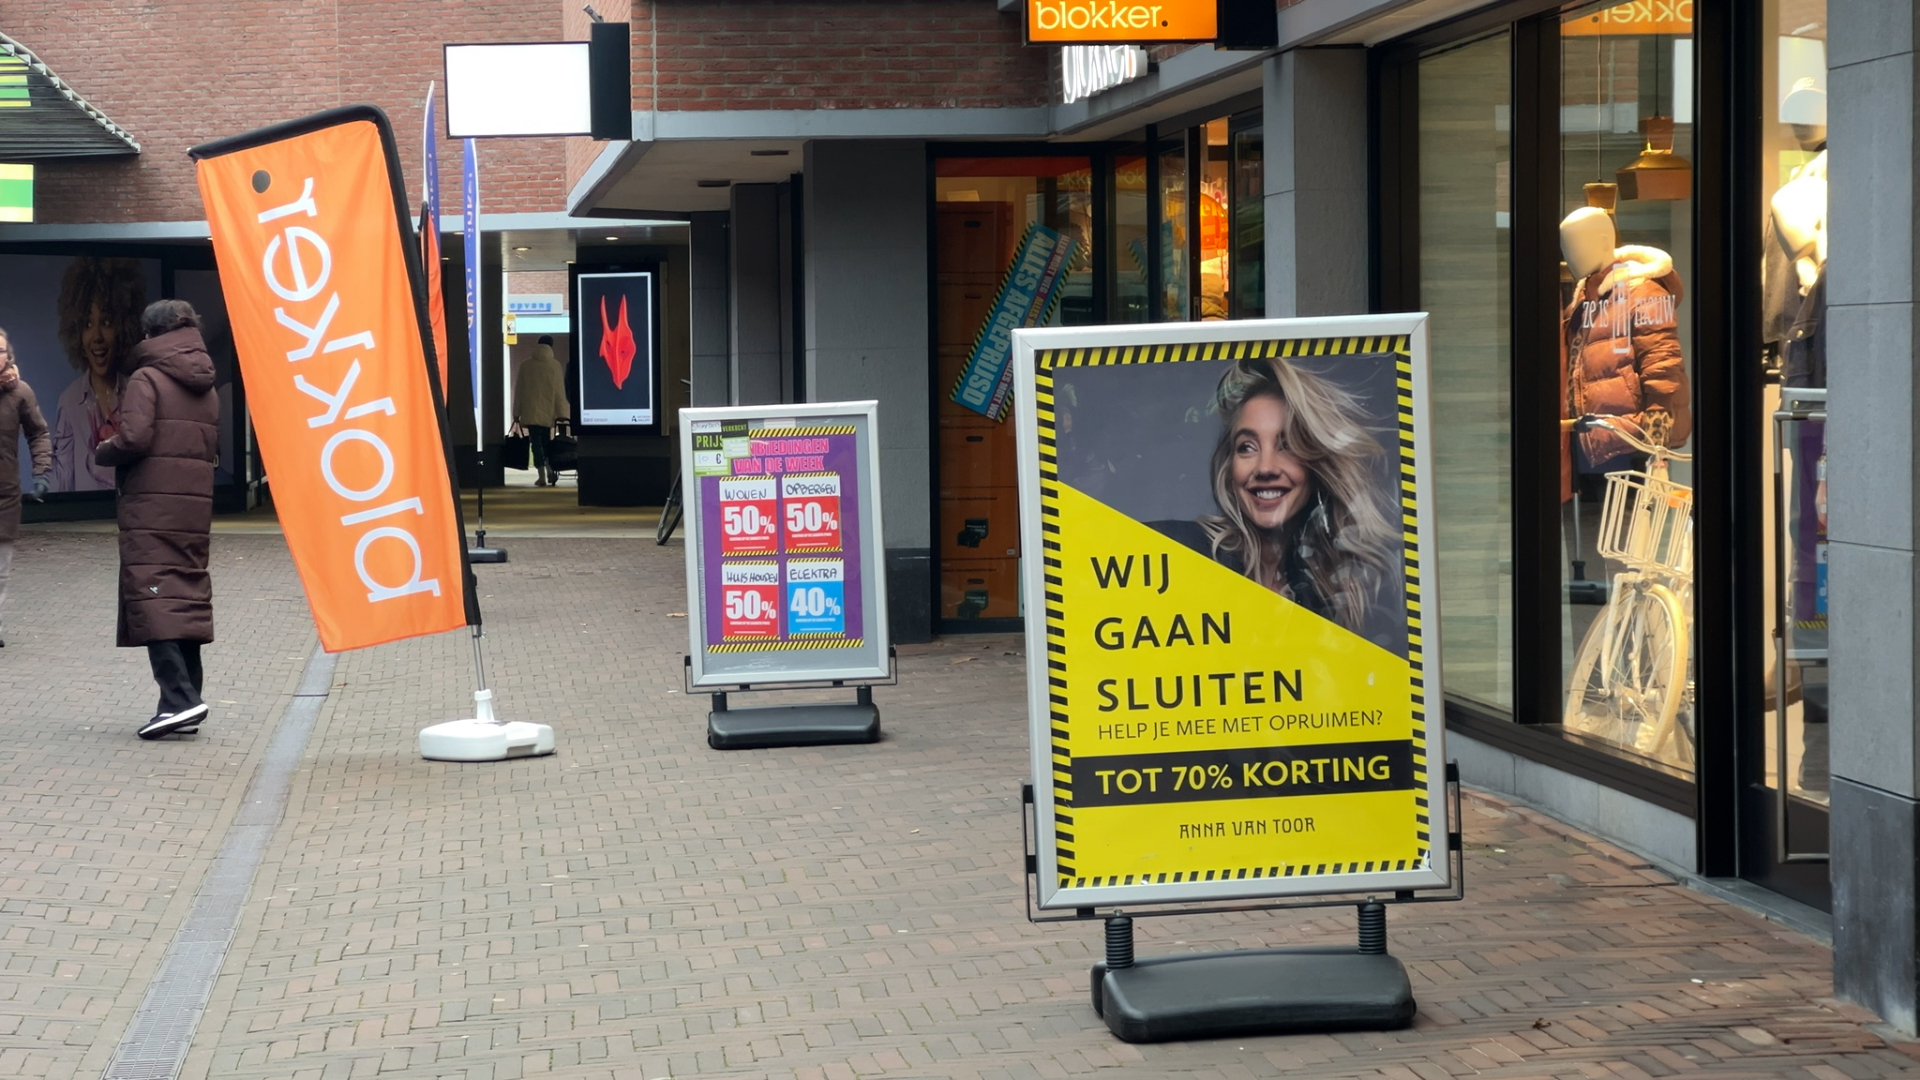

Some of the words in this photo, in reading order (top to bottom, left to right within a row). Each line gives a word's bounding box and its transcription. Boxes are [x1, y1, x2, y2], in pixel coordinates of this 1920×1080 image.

[1014, 230, 1056, 291] ALLES
[962, 287, 1030, 406] AFGEPRIJSD
[1002, 359, 1014, 383] LLES
[722, 424, 747, 432] VERKOCHT
[733, 457, 761, 474] VAN
[764, 456, 783, 473] DE
[785, 455, 824, 472] WEEK
[785, 482, 836, 496] OPBERGEN
[724, 505, 776, 535] 50%
[786, 502, 838, 533] 50%
[789, 567, 838, 581] ELEKTRA
[1090, 553, 1170, 595] WIJ
[725, 589, 777, 620] 50%
[790, 587, 841, 617] 40%
[1094, 612, 1232, 650] GAAN
[1097, 669, 1303, 712] SLUITEN
[1098, 722, 1148, 740] HELP
[1152, 721, 1170, 741] JE
[1176, 719, 1216, 736] MEE
[1222, 716, 1264, 734] MET
[1269, 710, 1383, 731] OPRUIMEN?
[1095, 768, 1162, 795] TOT
[1171, 764, 1233, 791] 70%
[1243, 755, 1391, 787] KORTING
[1179, 822, 1226, 839] ANNA
[1232, 819, 1267, 837] VAN
[1273, 817, 1316, 834] TOOR
